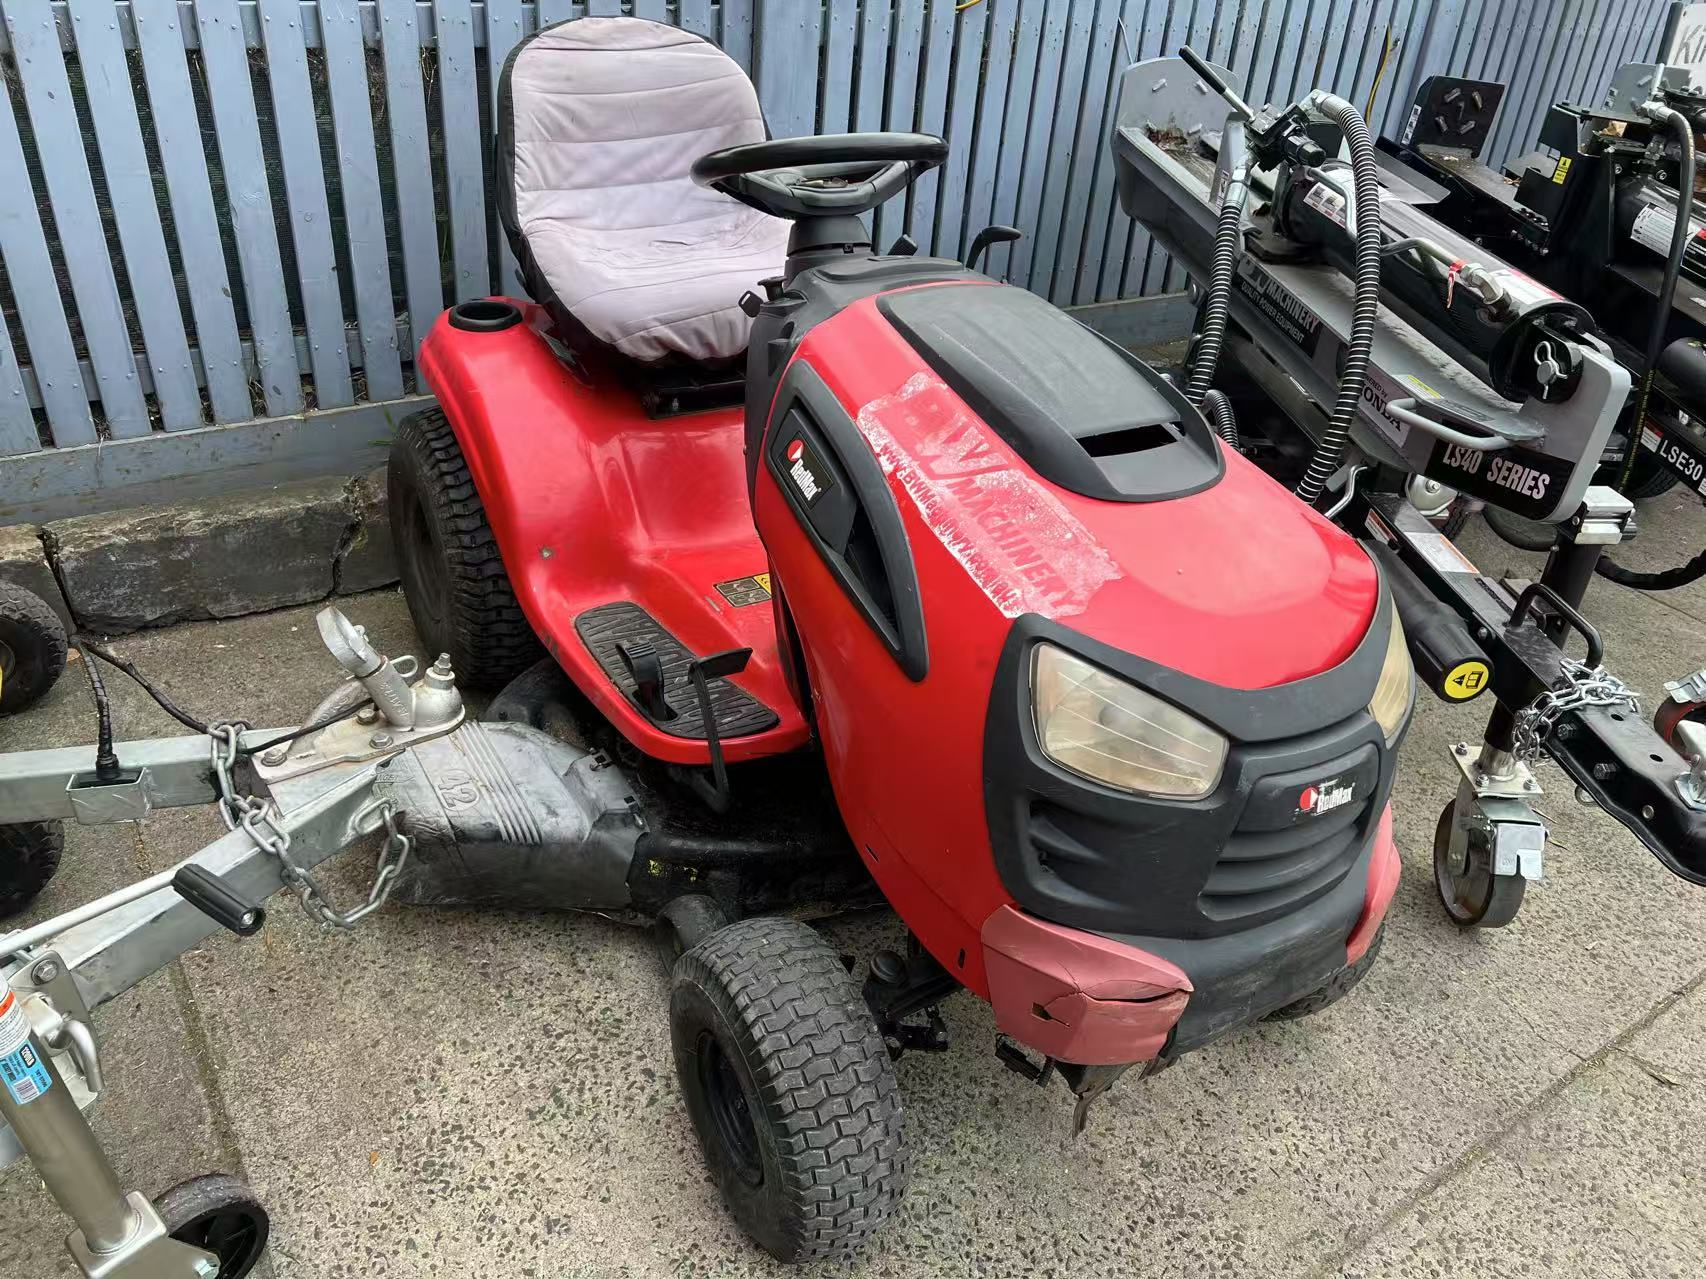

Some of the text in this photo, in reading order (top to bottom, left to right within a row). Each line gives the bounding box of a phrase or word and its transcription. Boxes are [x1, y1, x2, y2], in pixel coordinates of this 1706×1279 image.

[1266, 280, 1320, 333] MACHINERY
[789, 458, 819, 501] RedMax
[1442, 443, 1550, 500] LS40 SERIES
[1659, 439, 1703, 481] LSE30
[944, 476, 1087, 608] MACHINERY
